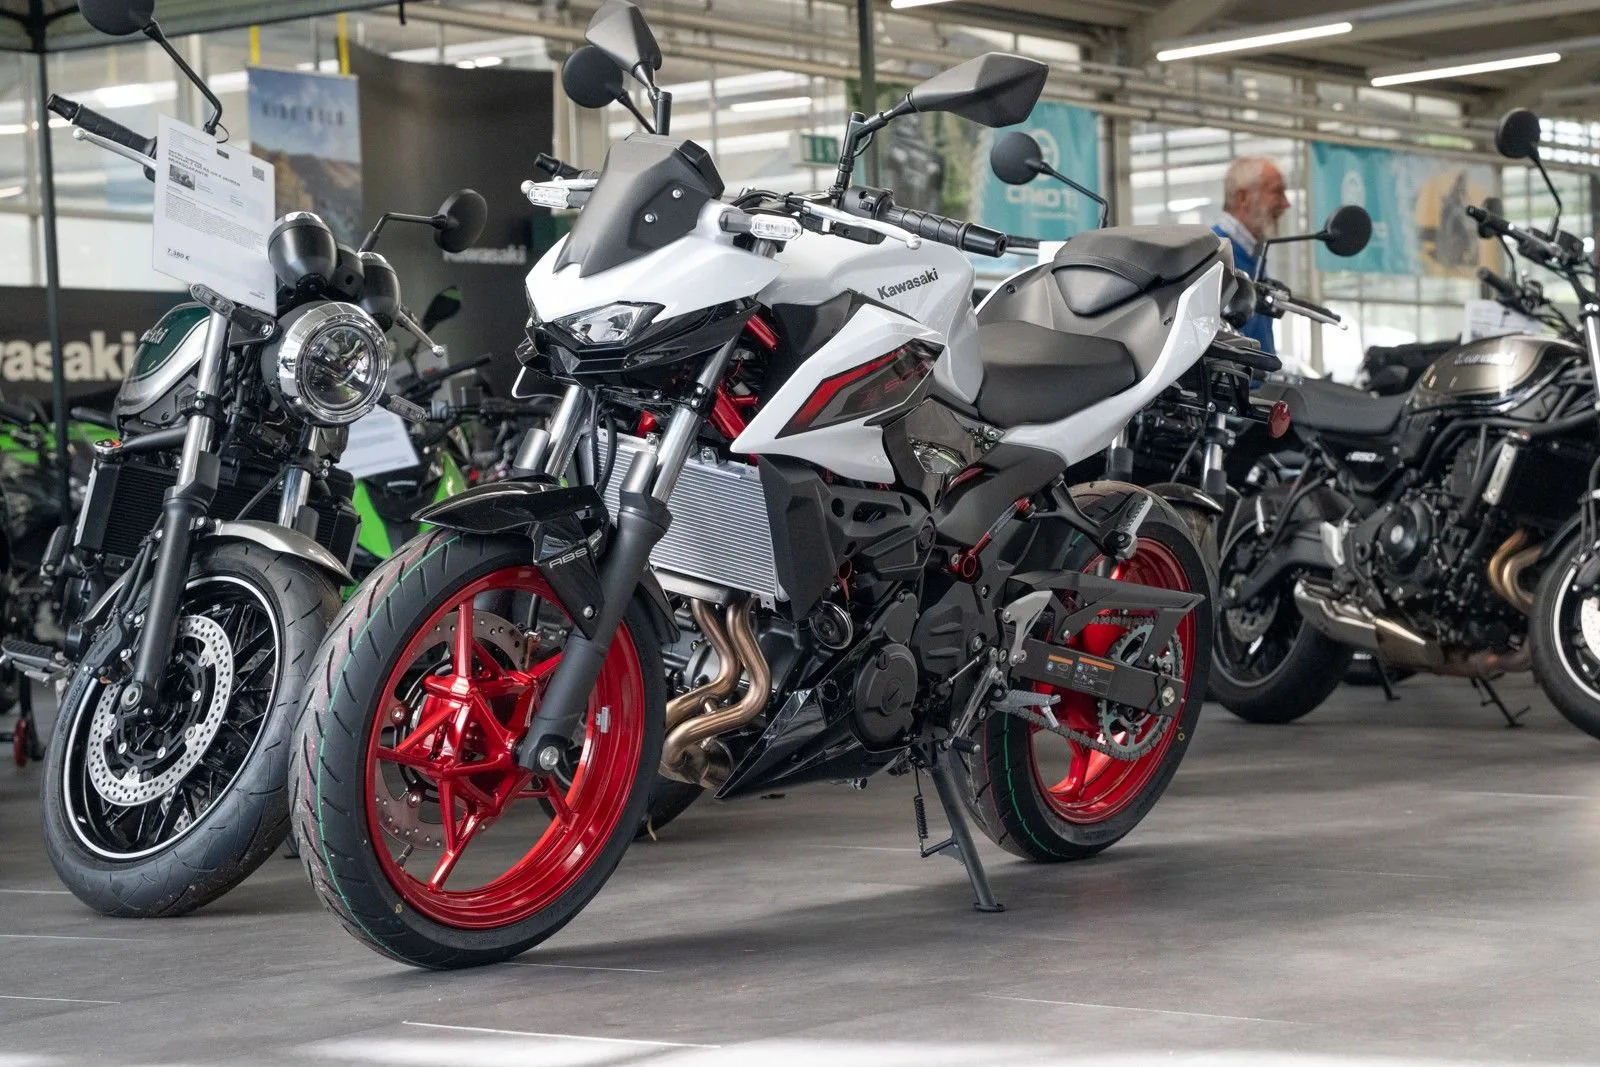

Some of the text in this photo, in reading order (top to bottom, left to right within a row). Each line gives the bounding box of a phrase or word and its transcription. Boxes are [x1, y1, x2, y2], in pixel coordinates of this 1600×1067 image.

[877, 267, 940, 300] Kawasaki
[0, 329, 137, 382] asaki
[549, 547, 588, 569] ABS
